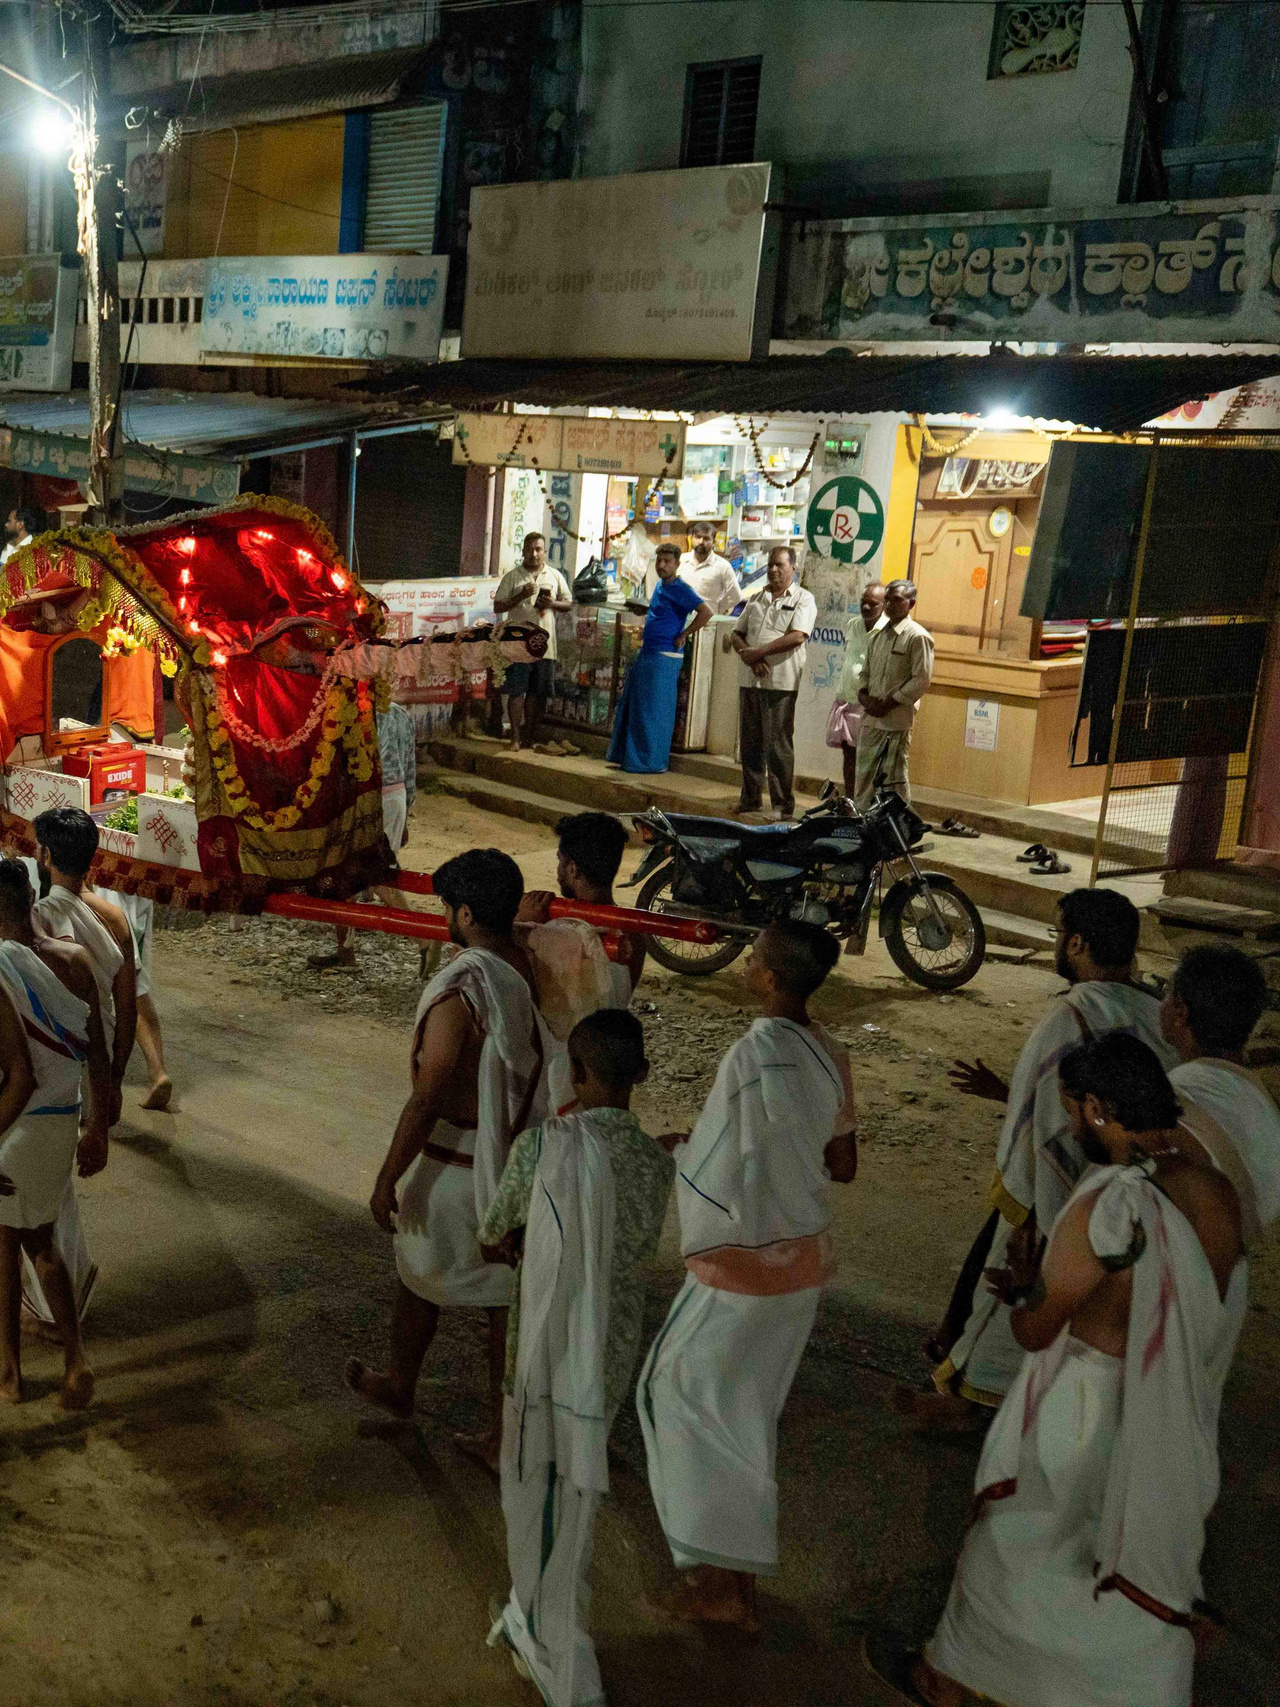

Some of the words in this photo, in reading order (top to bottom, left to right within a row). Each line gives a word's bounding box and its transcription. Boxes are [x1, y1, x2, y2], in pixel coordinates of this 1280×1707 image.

[896, 230, 1069, 309] ಕಲ್ಲೇಶ್ವರ
[1082, 221, 1220, 307] ಕ್ಲಾತ್
[107, 769, 133, 784] EXIDE
